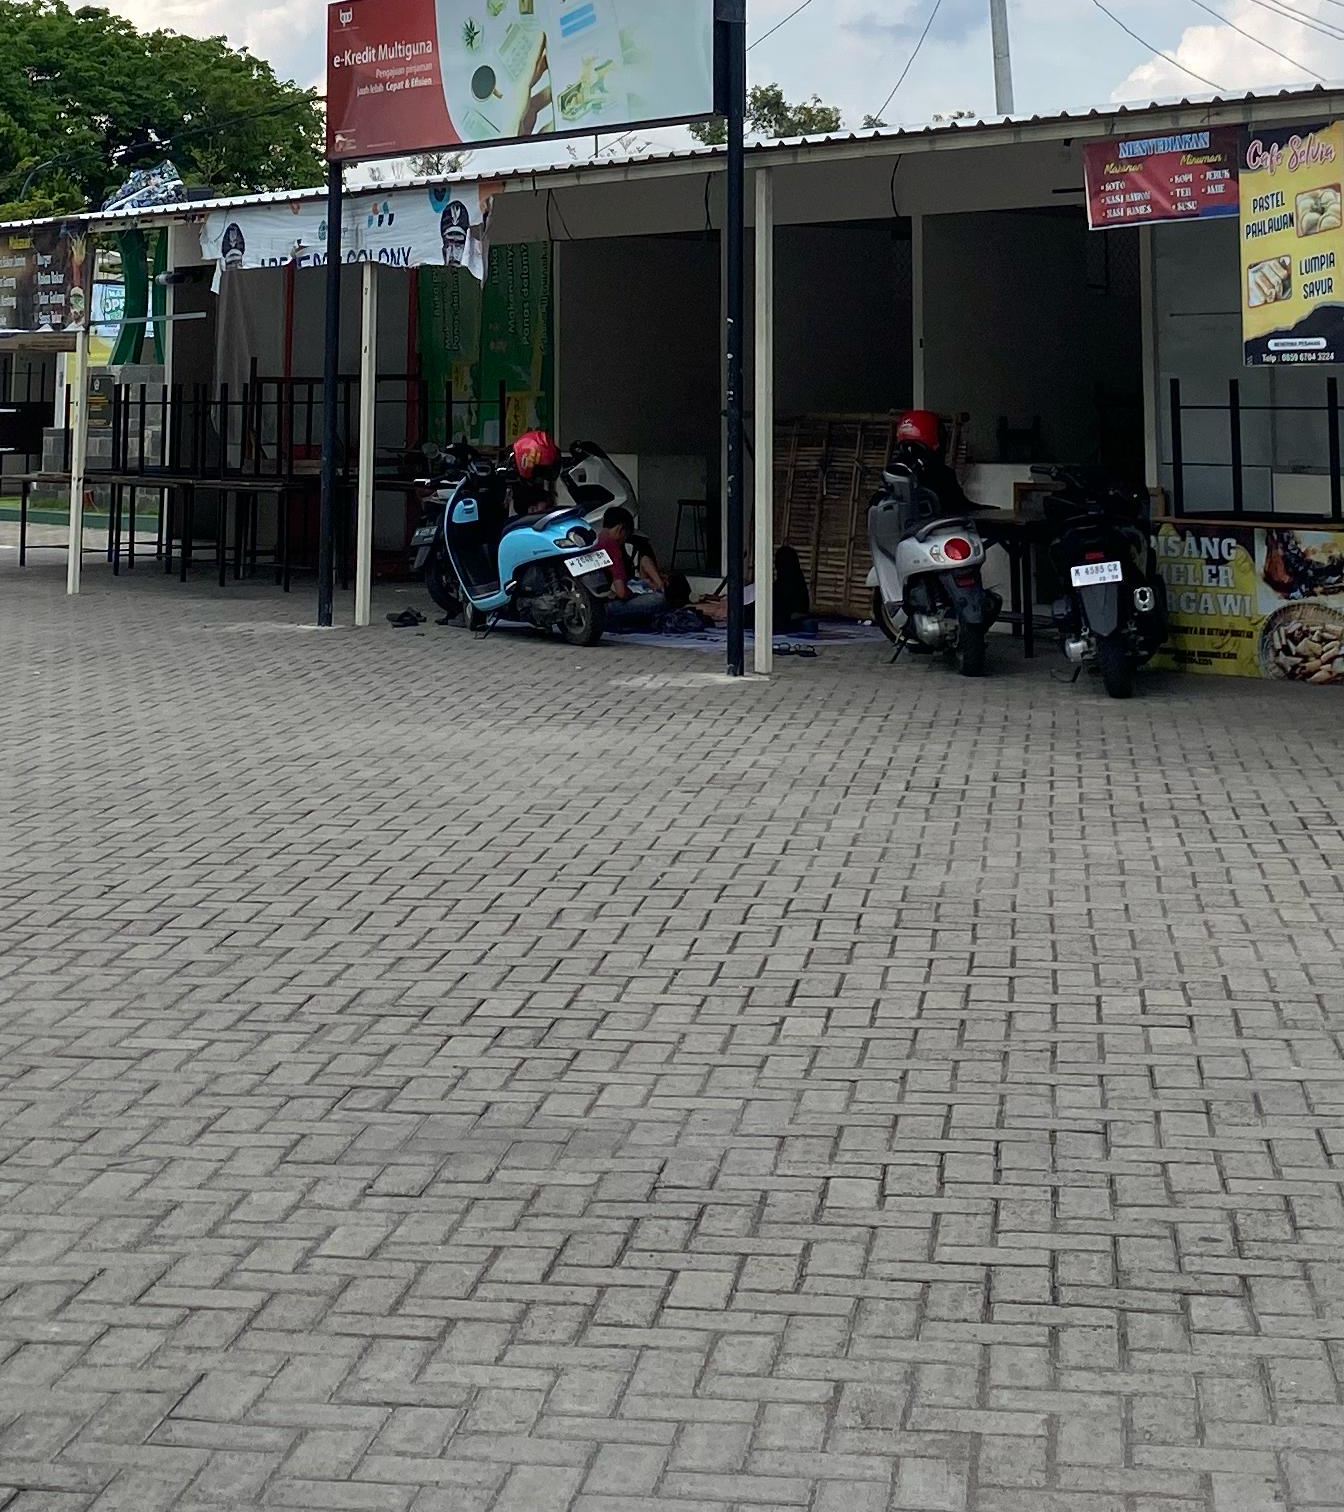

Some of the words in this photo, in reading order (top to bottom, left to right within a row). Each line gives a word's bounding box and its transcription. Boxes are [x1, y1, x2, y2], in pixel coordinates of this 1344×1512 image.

[333, 46, 376, 68] e-Kredit
[378, 40, 433, 61] Multiguna
[386, 80, 404, 92] Cepat
[1118, 131, 1210, 159] MENYEDIAKAN
[1180, 152, 1223, 166] Minuman
[1246, 139, 1284, 176] Cafe
[1105, 180, 1126, 191] SOTO
[1174, 173, 1193, 184] KOPI
[1105, 194, 1124, 204] NASI
[1176, 187, 1192, 198] TEH
[1177, 200, 1198, 211] SUSU
[1252, 190, 1286, 214] PASTEL
[1106, 207, 1124, 219] NASI
[1245, 211, 1295, 240] PAHLAWAN
[1299, 251, 1335, 276] LUMPIA
[1302, 276, 1333, 300] SAYUR
